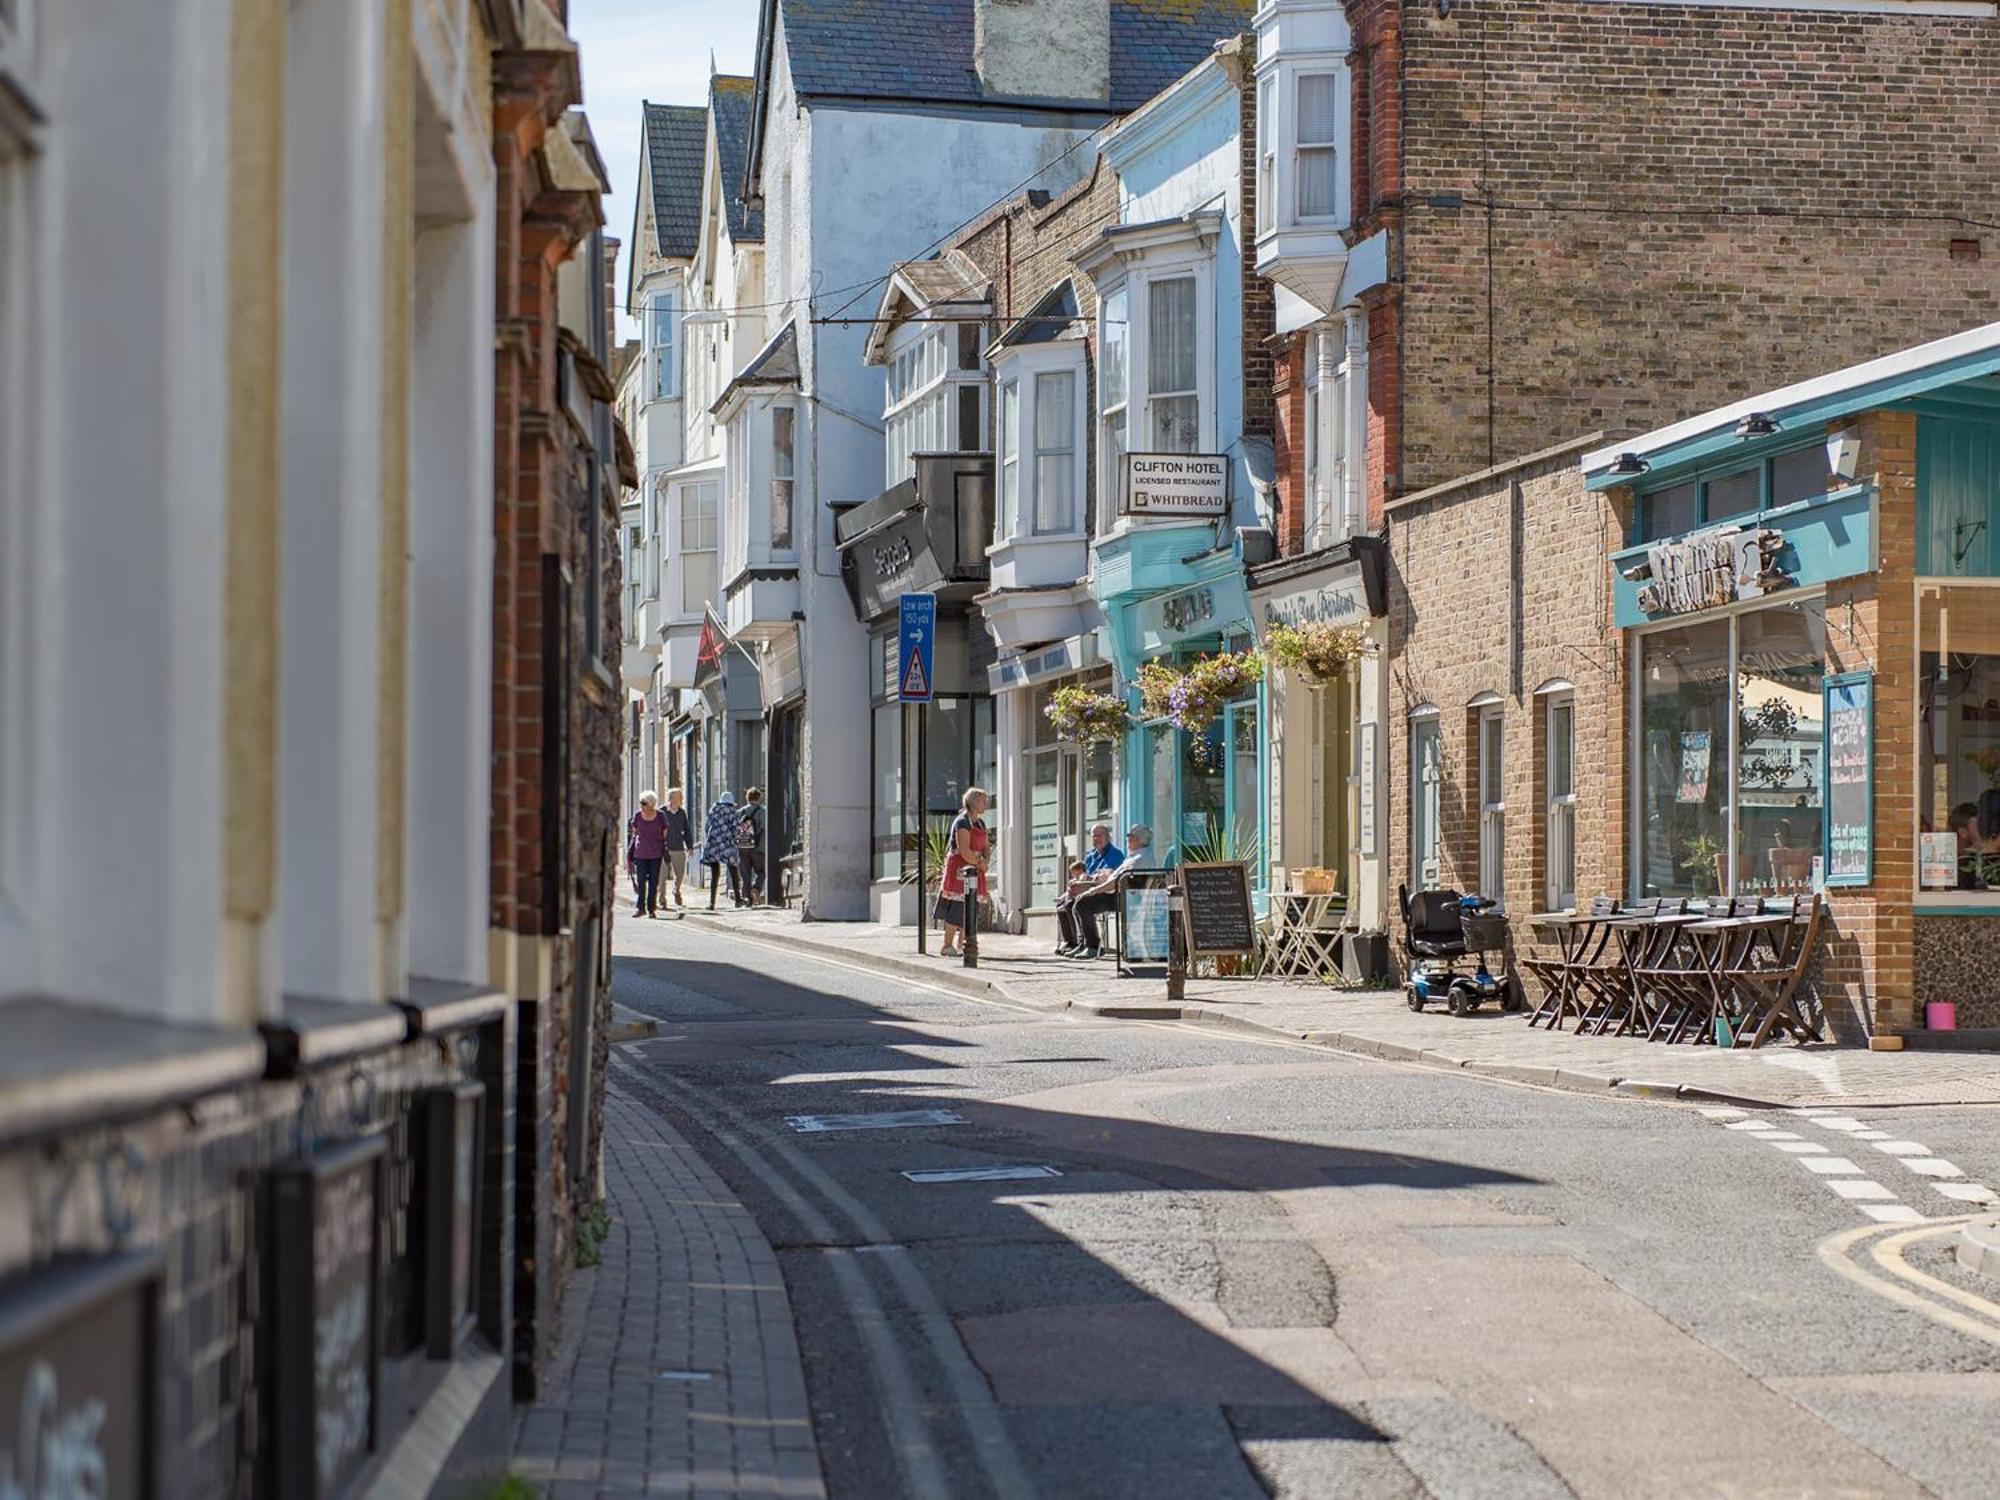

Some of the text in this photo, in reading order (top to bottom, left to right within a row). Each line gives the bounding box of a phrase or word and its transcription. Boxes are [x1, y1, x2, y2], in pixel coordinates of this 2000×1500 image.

[1133, 461, 1224, 474] CLIFTON HOTEL
[1135, 477, 1221, 486] LICENSED RESTAURANT
[1151, 495, 1222, 507] WHITBREAD
[903, 599, 933, 611] Low arch
